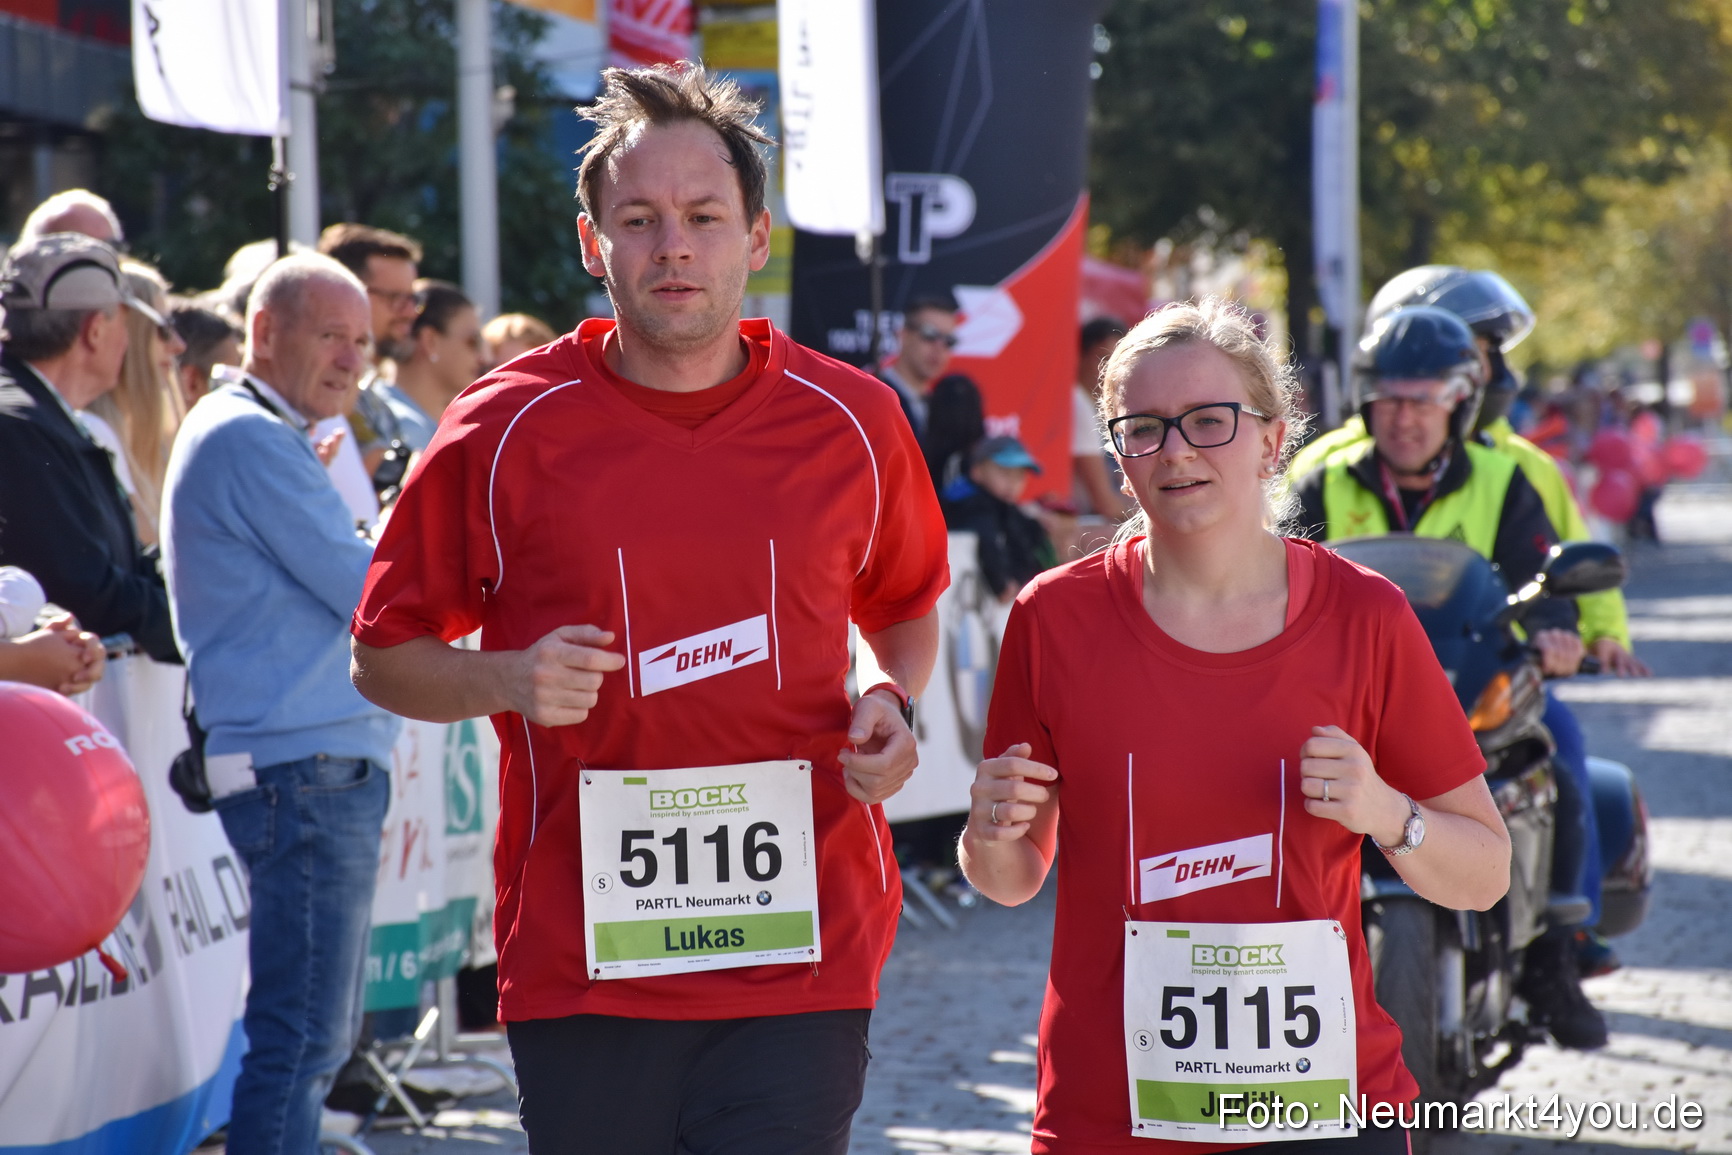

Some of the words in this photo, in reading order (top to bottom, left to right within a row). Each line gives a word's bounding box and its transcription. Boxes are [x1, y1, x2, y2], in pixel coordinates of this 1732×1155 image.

[676, 638, 733, 673] DEHN
[650, 783, 748, 810] BOCK
[650, 811, 680, 819] inspired
[682, 810, 692, 818] by
[716, 805, 750, 814] concepts
[620, 821, 782, 888] 5116
[1175, 854, 1236, 884] DEHN
[635, 897, 683, 911] PARTL
[686, 893, 752, 908] Neumarkt
[664, 924, 745, 951] Lukas
[1192, 943, 1286, 967] BOCK
[1191, 967, 1221, 976] inspired
[1222, 968, 1232, 976] by
[1233, 968, 1254, 976] smart
[1256, 967, 1288, 975] concepts
[1160, 985, 1321, 1050] 5115
[1175, 1061, 1222, 1073] PARTL
[1225, 1061, 1291, 1074] Neumarkt
